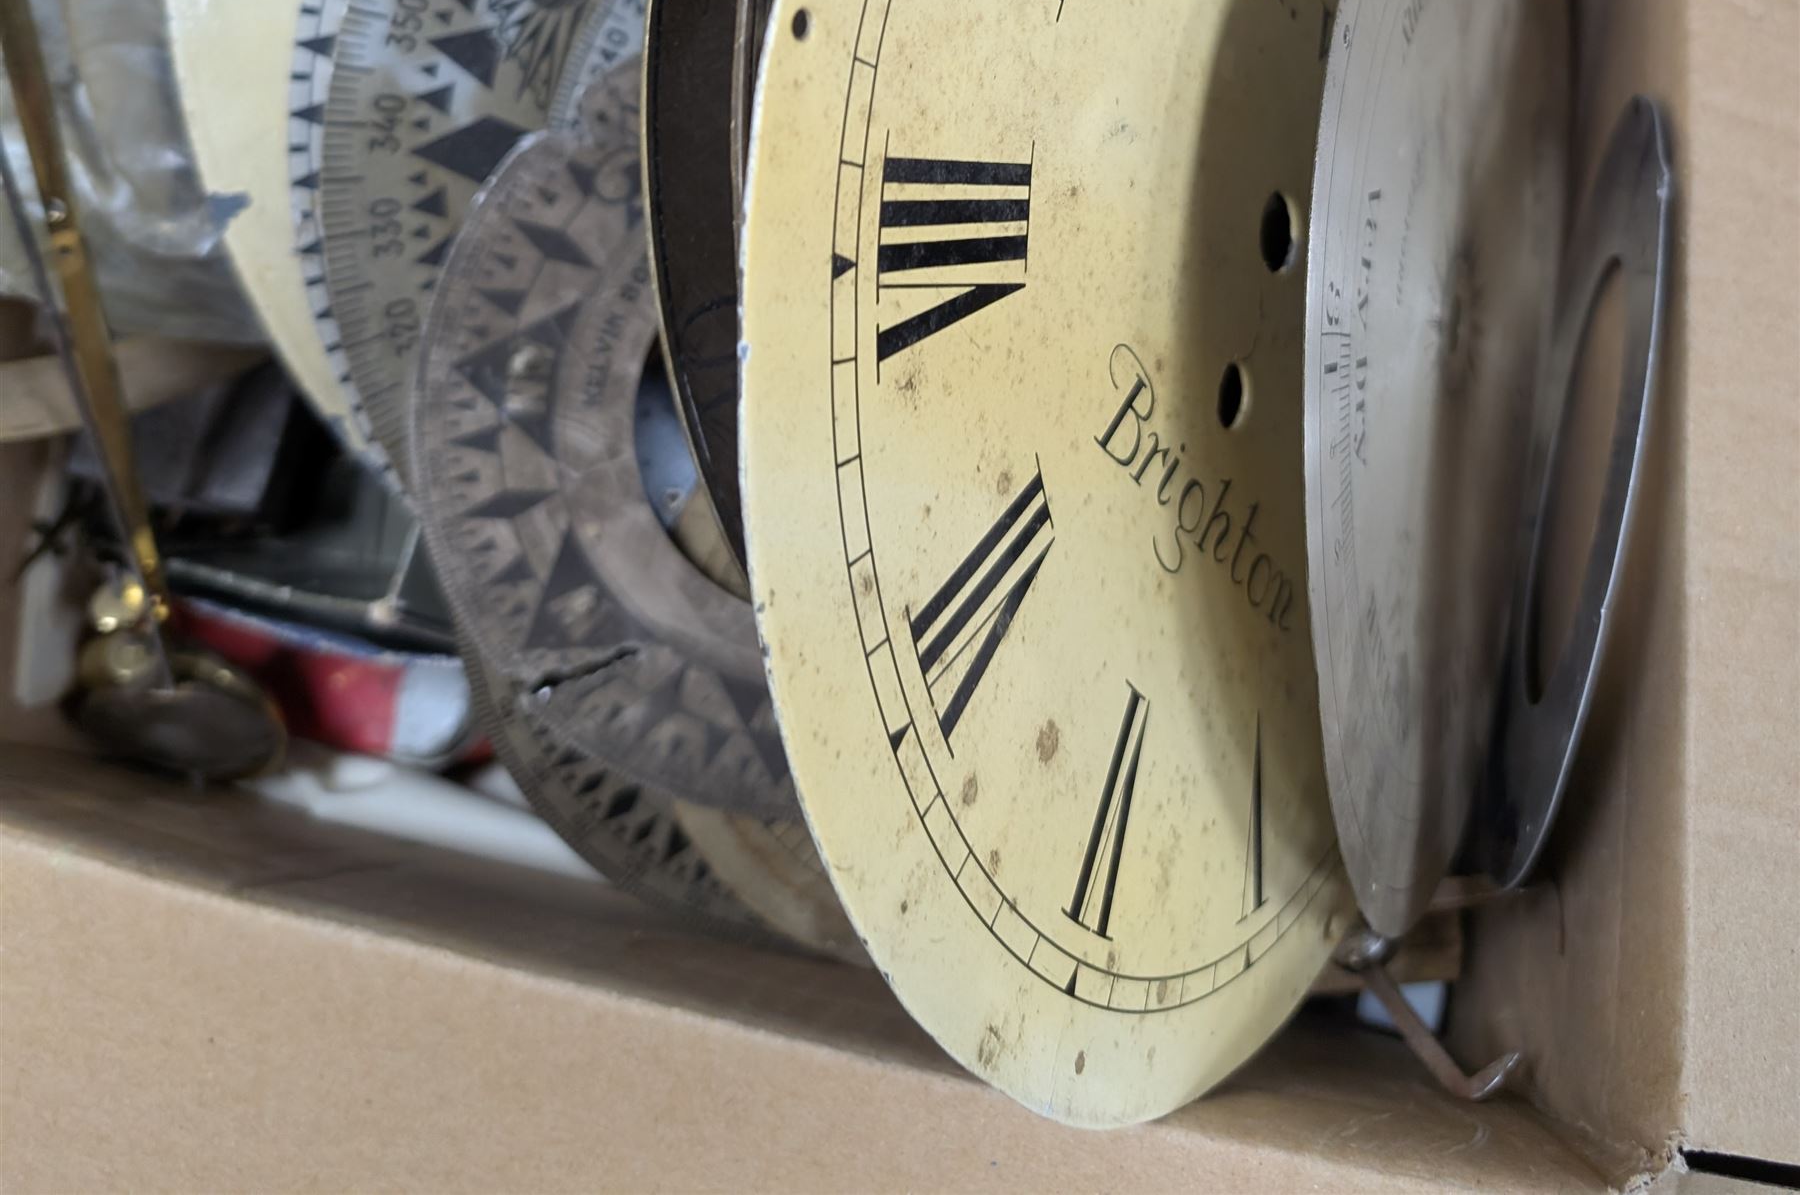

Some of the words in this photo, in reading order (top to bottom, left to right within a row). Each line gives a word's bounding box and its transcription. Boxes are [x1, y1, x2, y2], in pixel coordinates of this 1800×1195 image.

[369, 93, 407, 155] 340
[875, 129, 1034, 387] VIII
[905, 452, 1055, 759] VII
[1094, 343, 1294, 632] Brighton
[1061, 679, 1150, 941] VI
[1236, 708, 1270, 925] V
